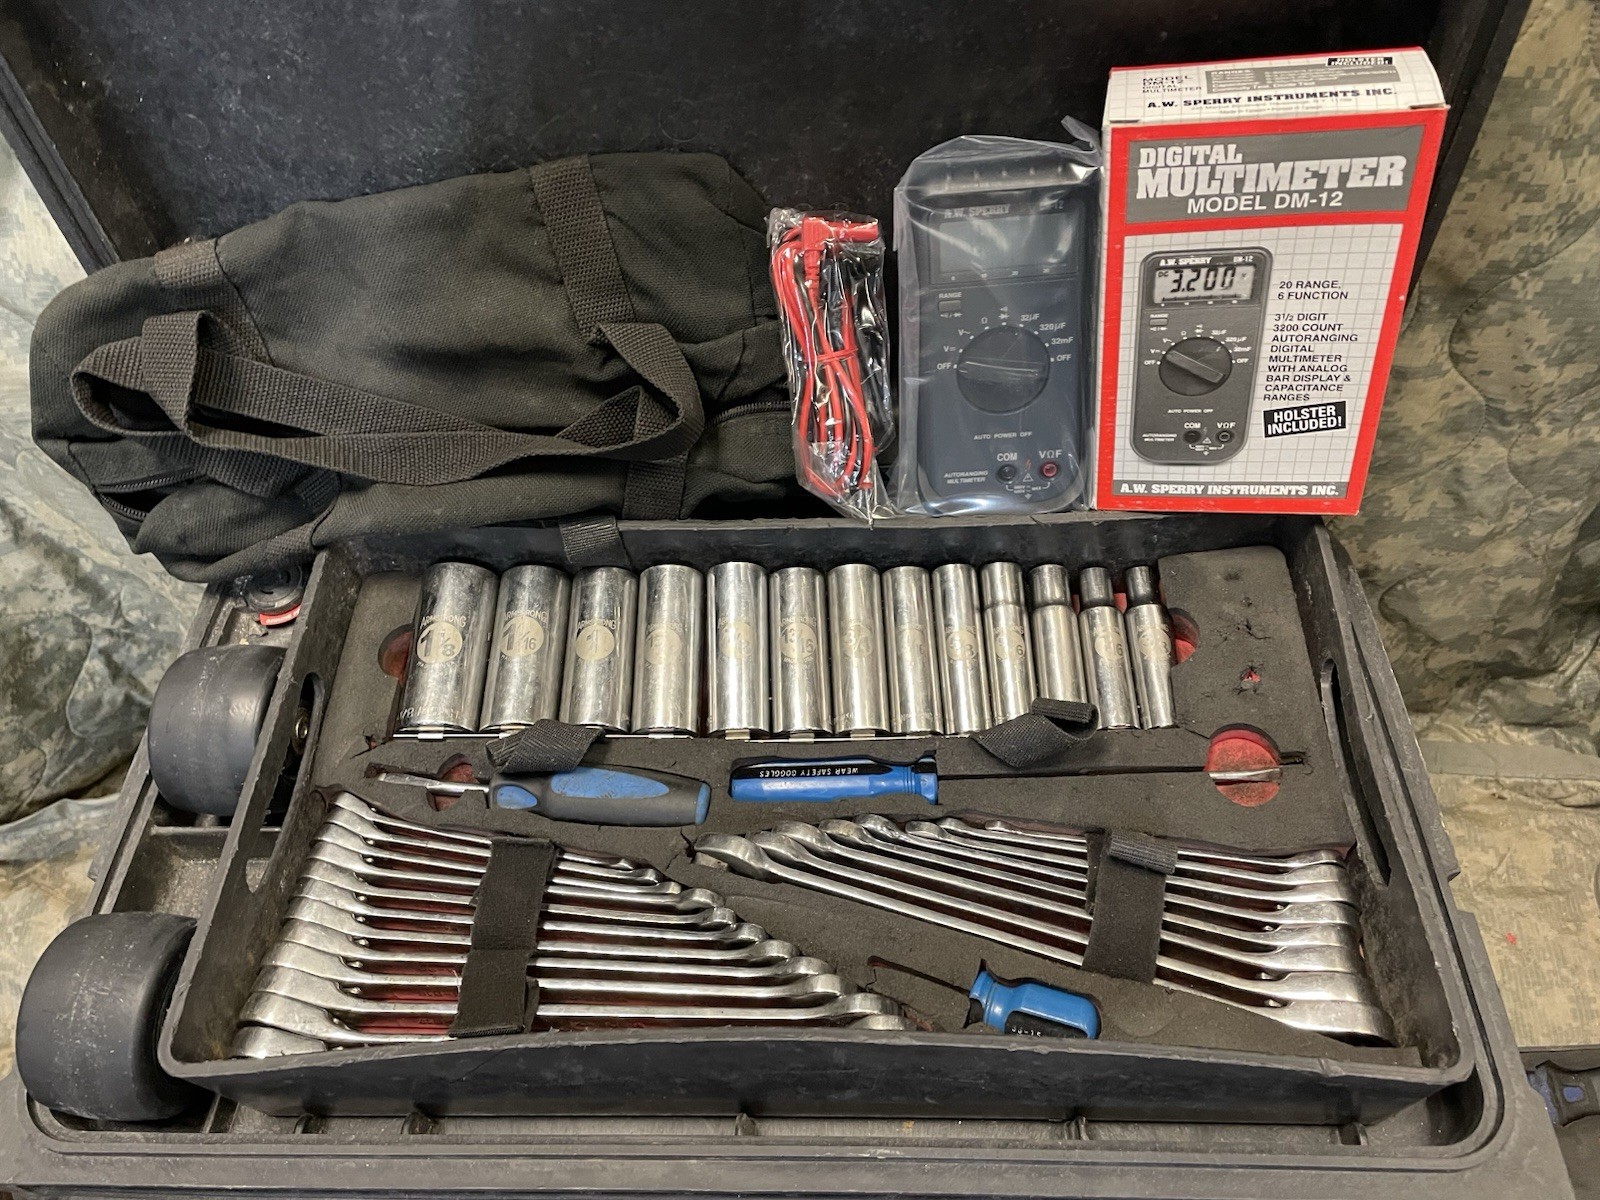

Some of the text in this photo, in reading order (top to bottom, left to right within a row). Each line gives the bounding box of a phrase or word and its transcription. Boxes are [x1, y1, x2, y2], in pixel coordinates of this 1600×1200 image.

[1142, 75, 1194, 83] MODEL
[1142, 86, 1202, 94] MULTIMETER
[1147, 101, 1178, 109] A.W.
[1183, 96, 1242, 107] SPERRY
[1246, 89, 1361, 103] INSTRUMENTS
[1365, 87, 1398, 96] INC.
[1139, 143, 1243, 168] DIGITAL
[1136, 154, 1408, 200] MULTIMETER
[1187, 190, 1344, 214] MODEL DM-12
[968, 204, 1011, 217] SPERRY
[1159, 256, 1213, 267] A.W. SPERRY
[1157, 270, 1169, 278] DC
[1170, 266, 1237, 294] 3.200
[1279, 280, 1293, 289] 20
[1277, 291, 1349, 300] 6 FUNCTION
[1297, 313, 1329, 321] DIGIT
[1272, 323, 1344, 332] 3200 COUNT
[1051, 336, 1074, 345] 32mF
[1271, 333, 1359, 343] AUTORANGING
[1270, 344, 1315, 353] DIGITAL
[1056, 353, 1072, 362] OFF
[1268, 354, 1343, 363] MULTIMETER
[936, 362, 952, 371] OFF
[1267, 364, 1348, 373] WITH ANALOG
[1265, 374, 1351, 383] BAR DISPLAY &
[1264, 384, 1344, 392] CAPACITANCE
[1263, 393, 1310, 402] RANGES
[1273, 405, 1336, 424] HOLSTER
[1267, 416, 1343, 436] INCLUDED!
[973, 433, 992, 441] AUTO
[997, 452, 1018, 462] COM
[943, 470, 989, 478] AUTORANGING
[1120, 483, 1340, 496] A.W. SPERRY INSTRUMENTS INC.
[420, 613, 467, 629] ARMSTRONG
[502, 623, 516, 651] 1
[420, 630, 433, 657] 1
[759, 767, 859, 778] WEAR SAFETY GOGGLES
